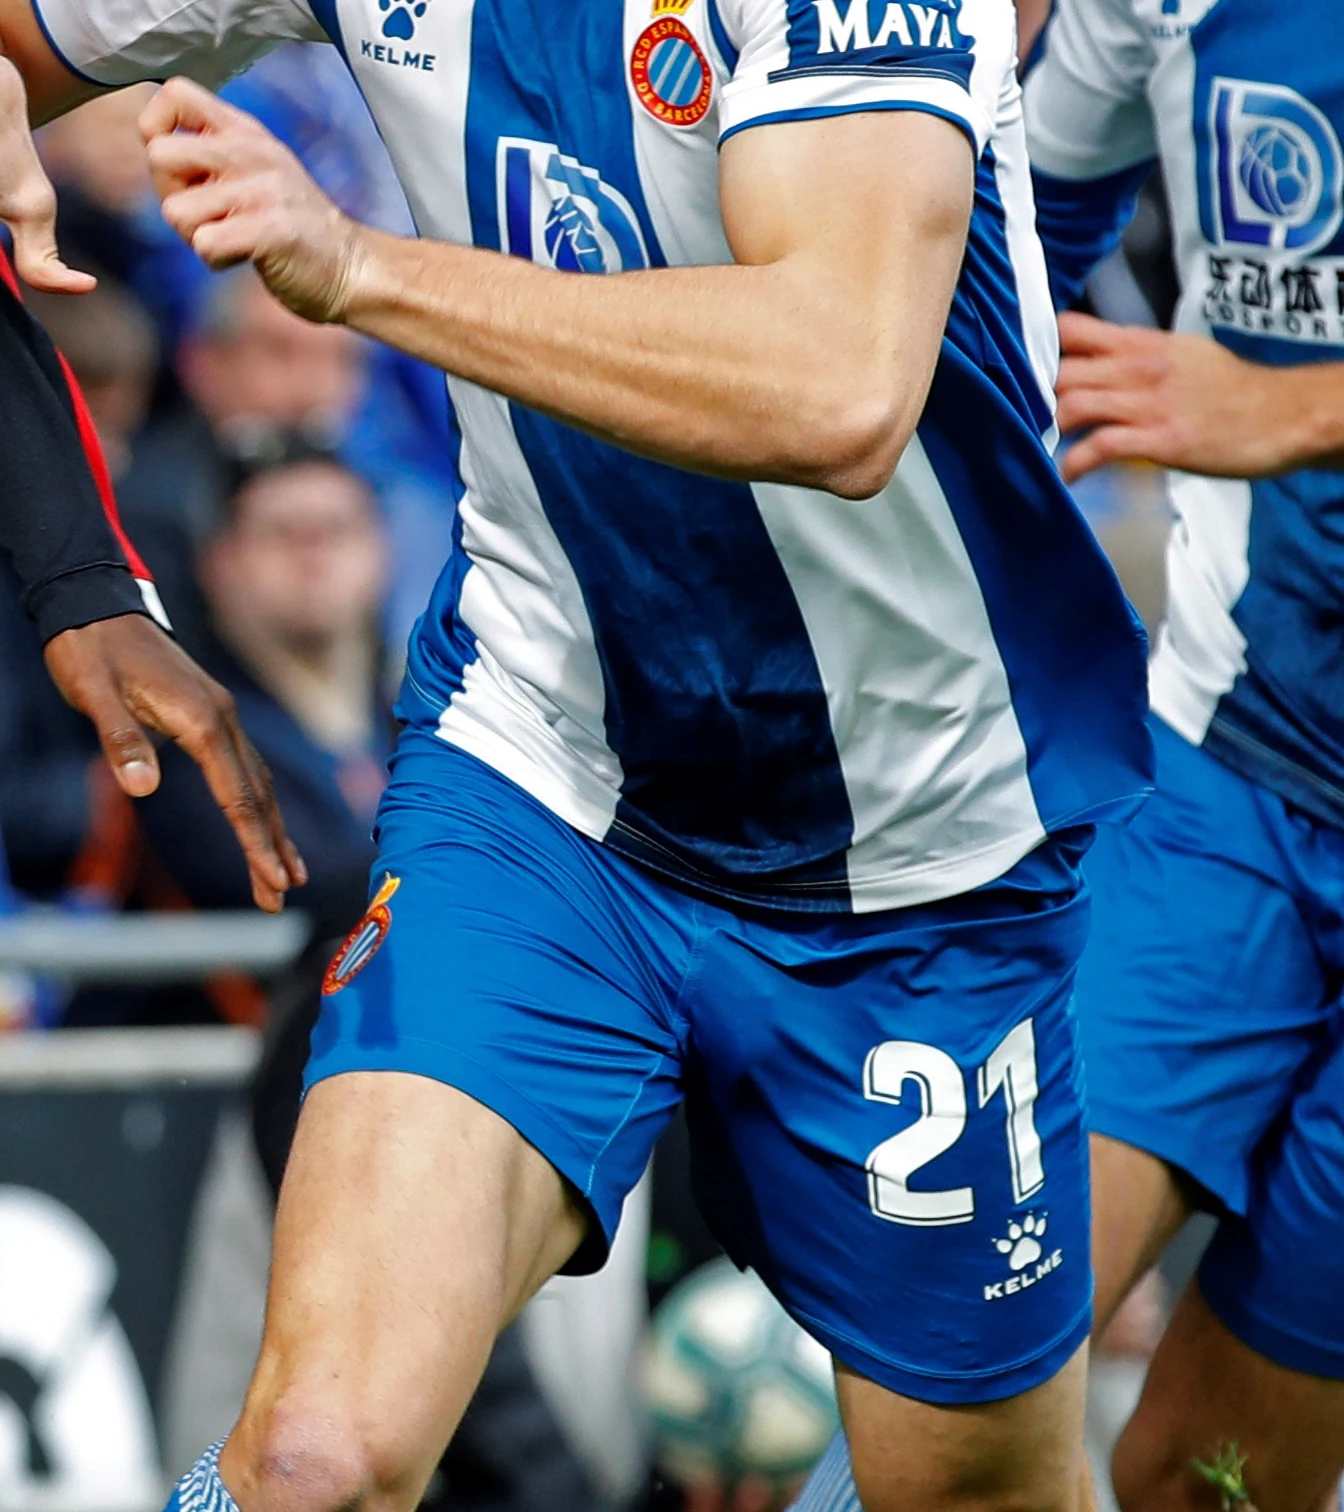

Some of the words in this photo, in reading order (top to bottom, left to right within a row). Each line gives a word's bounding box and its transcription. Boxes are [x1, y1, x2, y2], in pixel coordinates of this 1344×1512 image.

[811, 0, 954, 54] MAYA
[360, 39, 436, 71] KELME
[1206, 253, 1344, 316] 乐动体
[862, 1016, 1046, 1227] 21
[983, 1248, 1064, 1301] KELME
